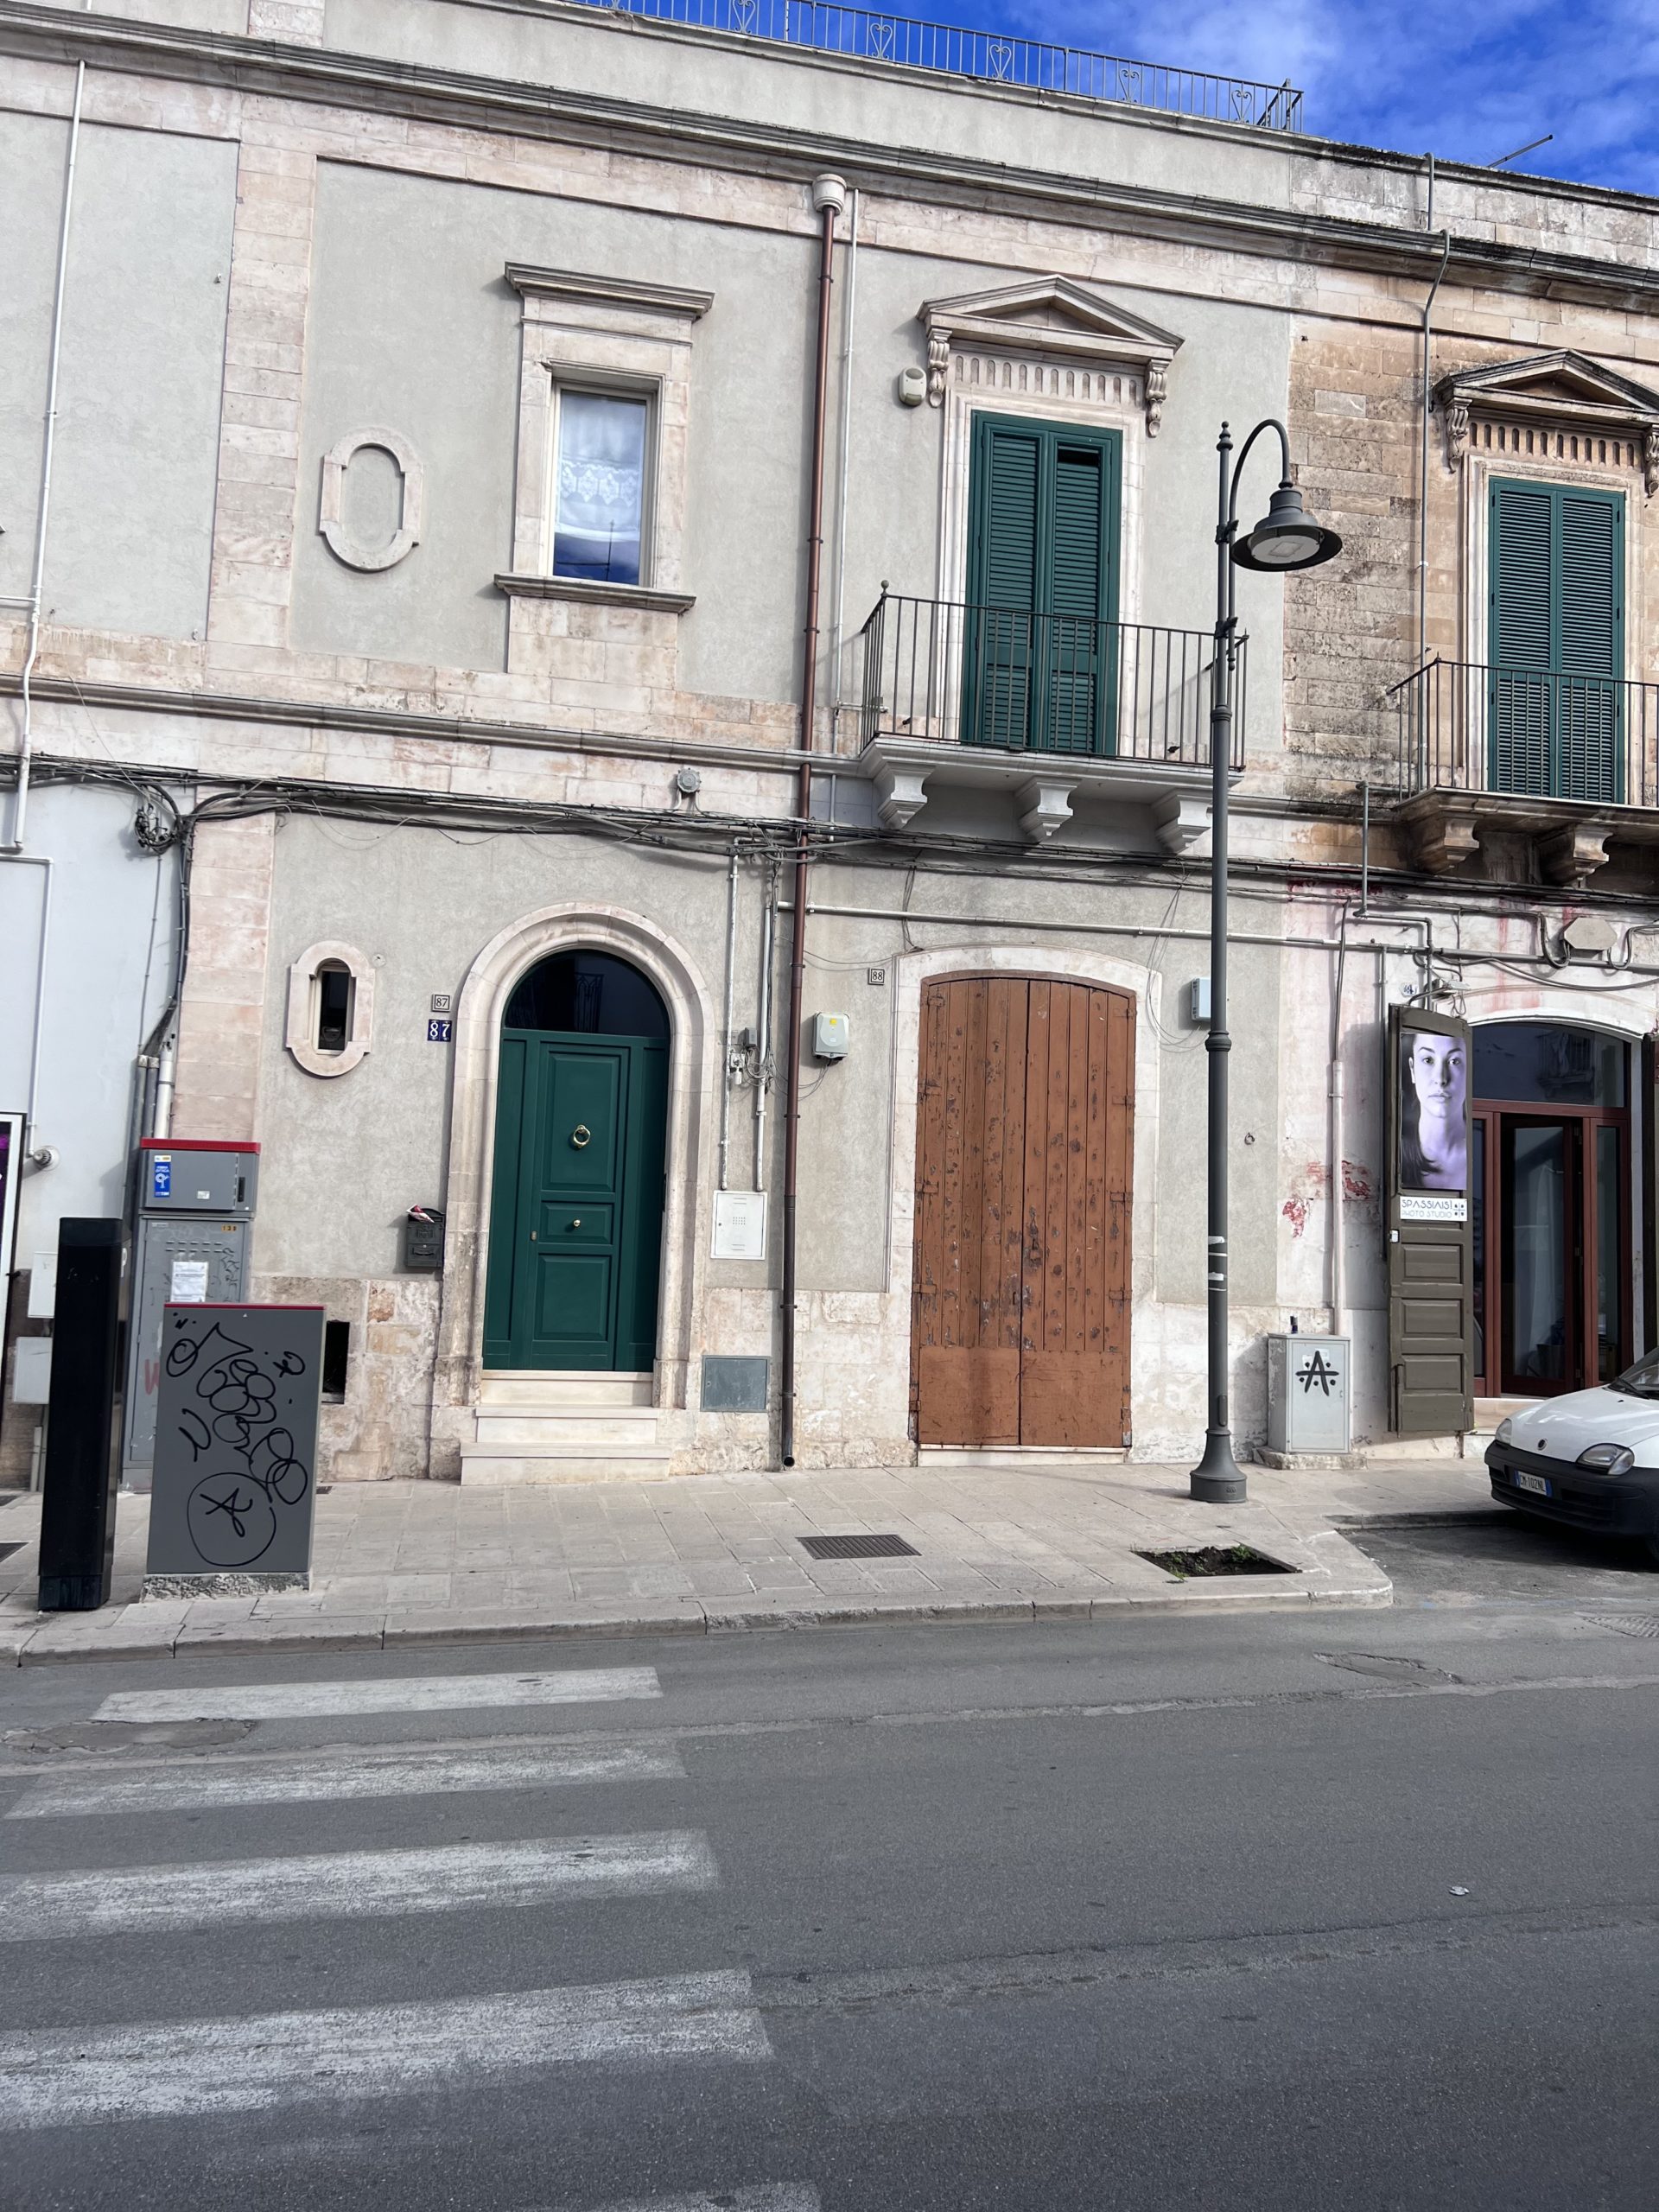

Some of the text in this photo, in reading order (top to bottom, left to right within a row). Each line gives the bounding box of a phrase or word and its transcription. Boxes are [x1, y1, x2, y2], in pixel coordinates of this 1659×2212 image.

[872, 971, 882, 981] 88
[435, 997, 448, 1007] 87
[429, 1022, 450, 1038] 87
